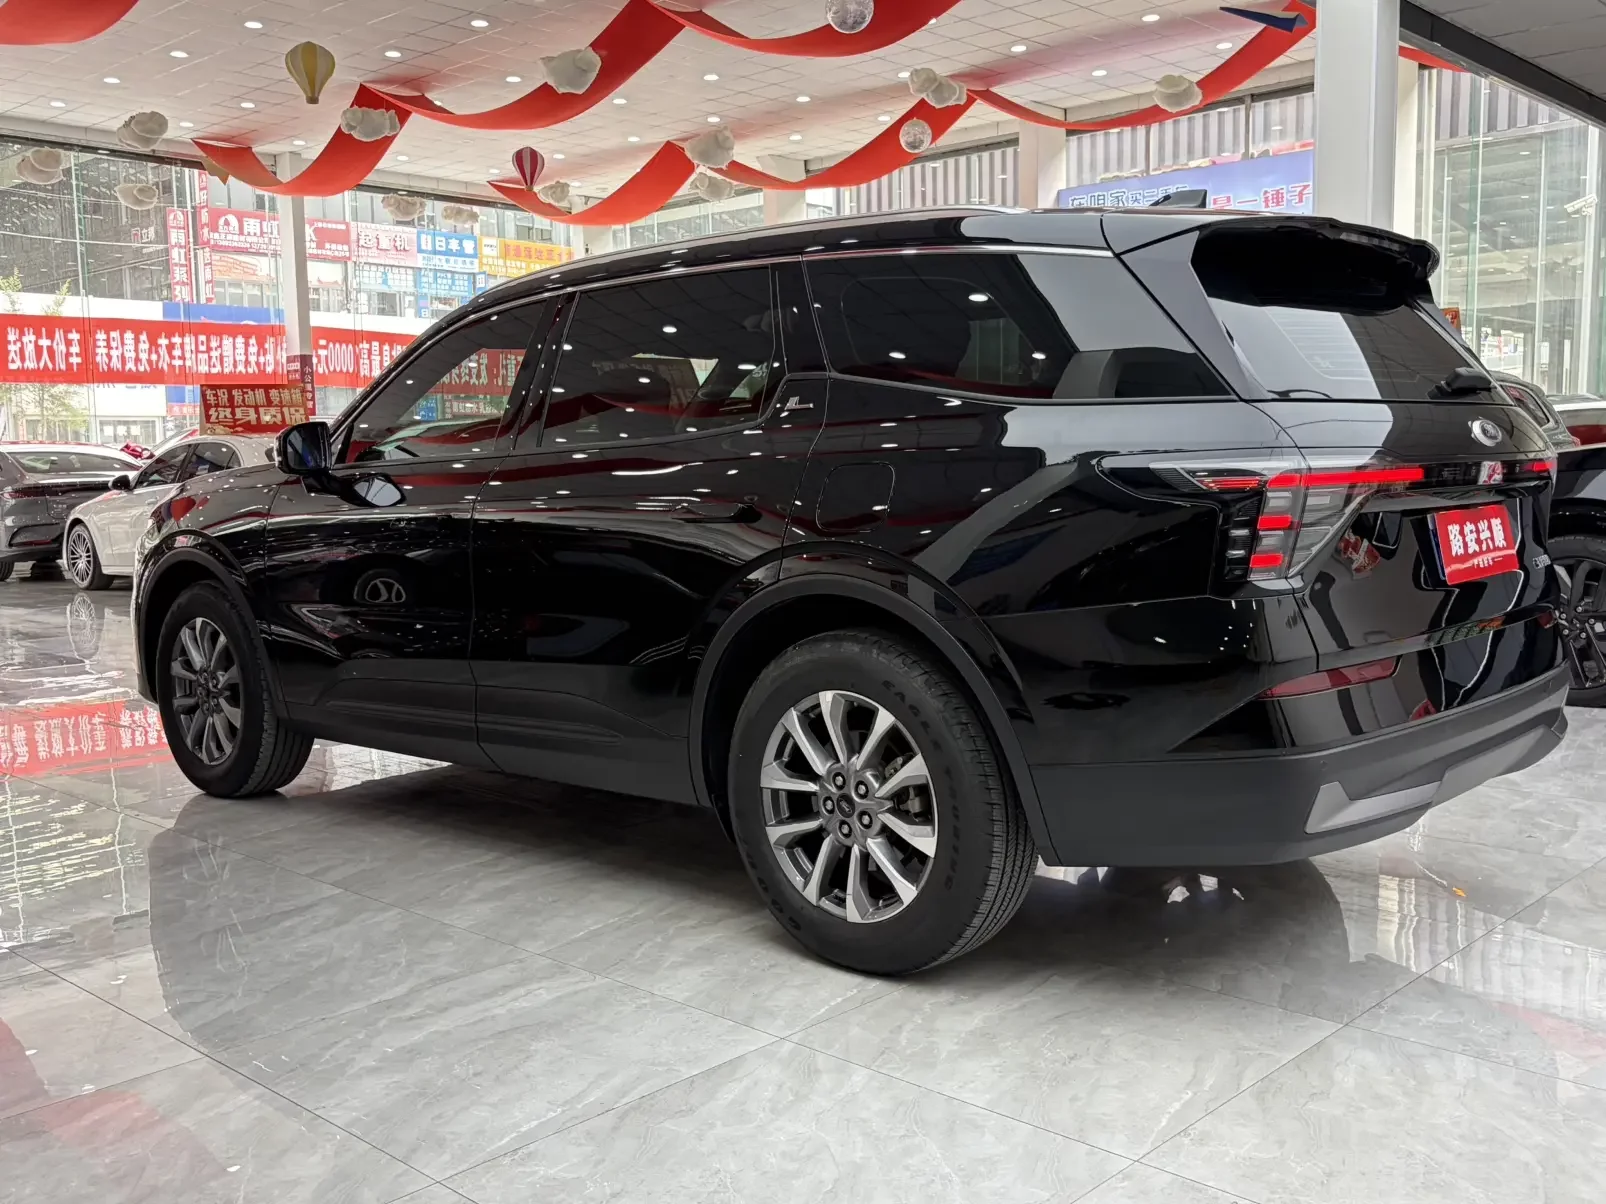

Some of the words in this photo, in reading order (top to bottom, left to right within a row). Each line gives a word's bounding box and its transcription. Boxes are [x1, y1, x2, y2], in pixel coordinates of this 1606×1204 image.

[205, 388, 230, 407] 车况
[232, 388, 267, 406] 发动机
[209, 407, 306, 426] 终身质保
[1447, 517, 1507, 557] 路安兴顺
